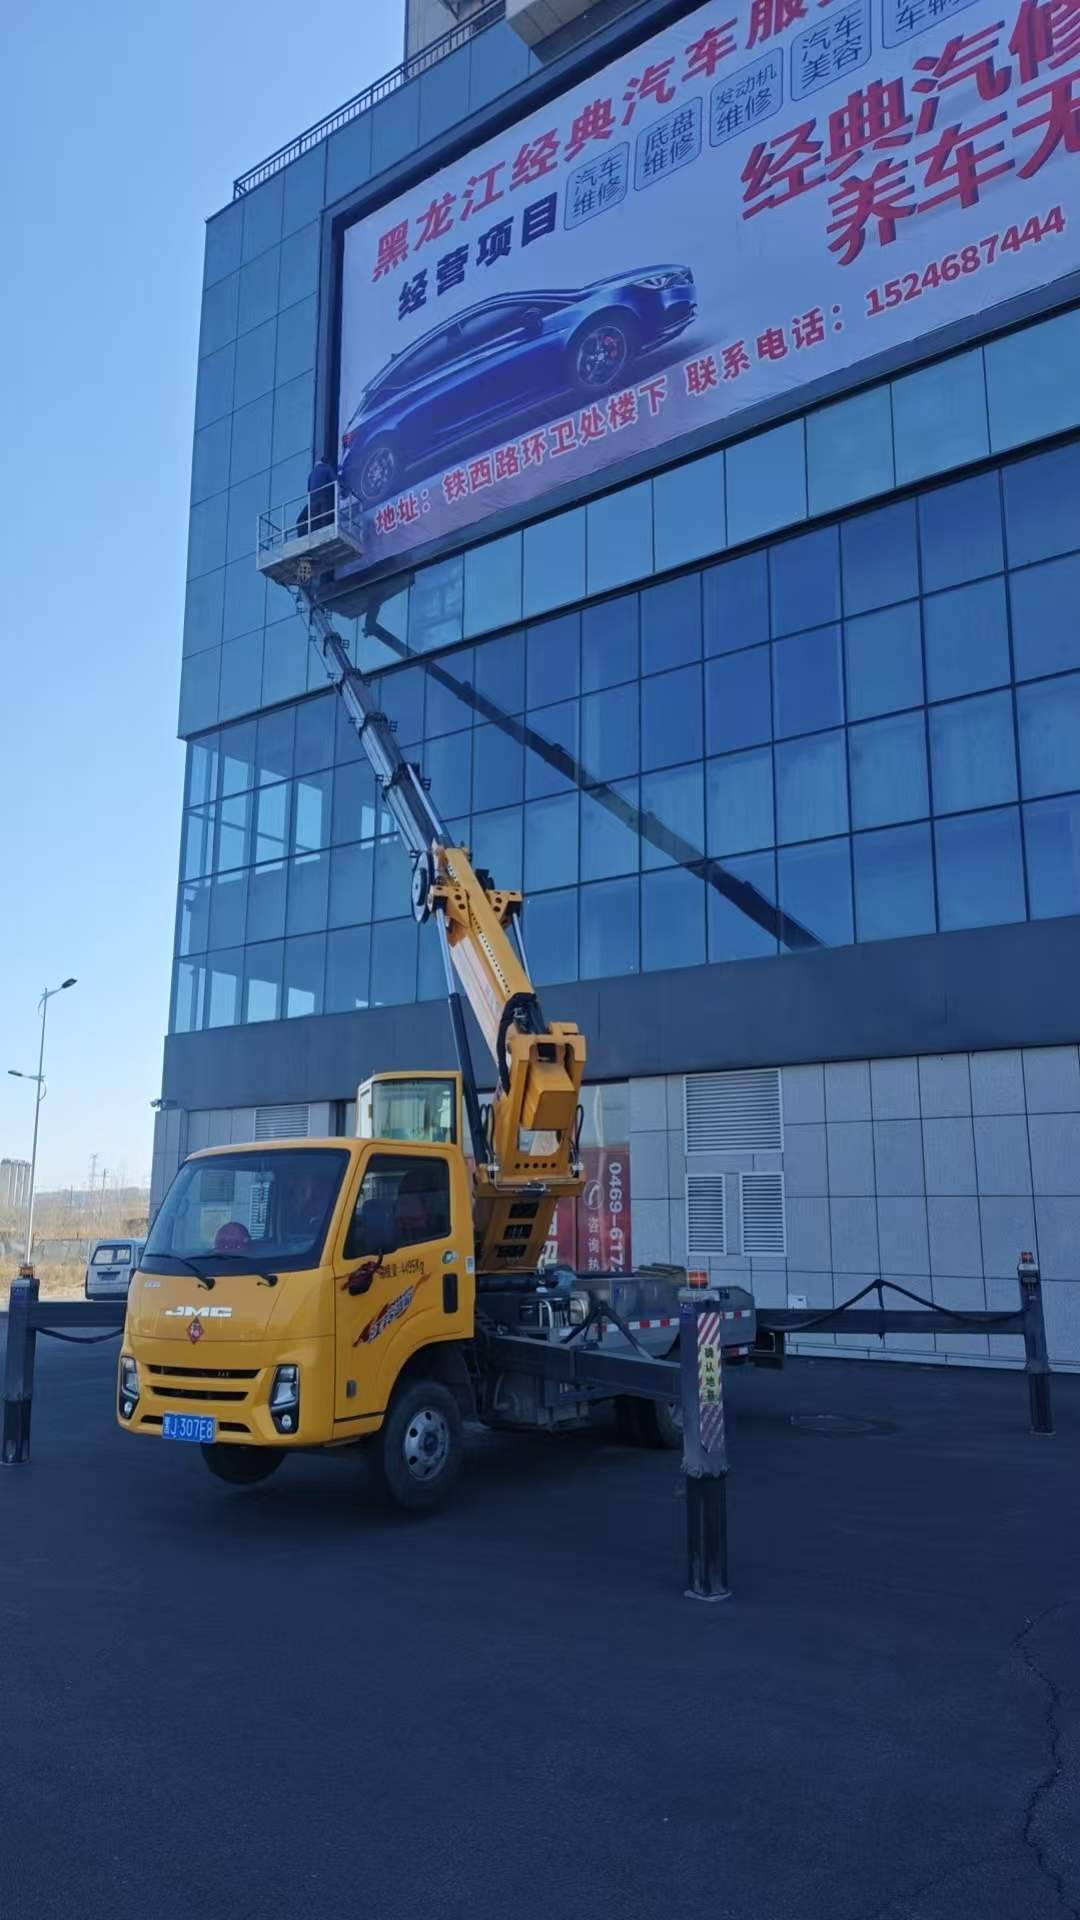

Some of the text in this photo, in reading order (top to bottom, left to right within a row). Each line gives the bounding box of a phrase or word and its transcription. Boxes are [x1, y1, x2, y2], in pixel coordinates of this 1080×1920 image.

[801, 8, 862, 61] 汽车
[716, 63, 776, 108] 发动机
[801, 35, 863, 89] 美容
[644, 108, 695, 156] 底盘
[717, 87, 773, 136] 维修
[740, 0, 1080, 220] 经典汽修
[371, 0, 836, 282] 黑龙江经典汽车服
[643, 135, 695, 176] 维修
[572, 177, 624, 218] 维修
[574, 152, 623, 194] 汽车
[398, 192, 558, 321] 经营项目
[865, 205, 1066, 317] 1524687444
[165, 1306, 232, 1317] JMC
